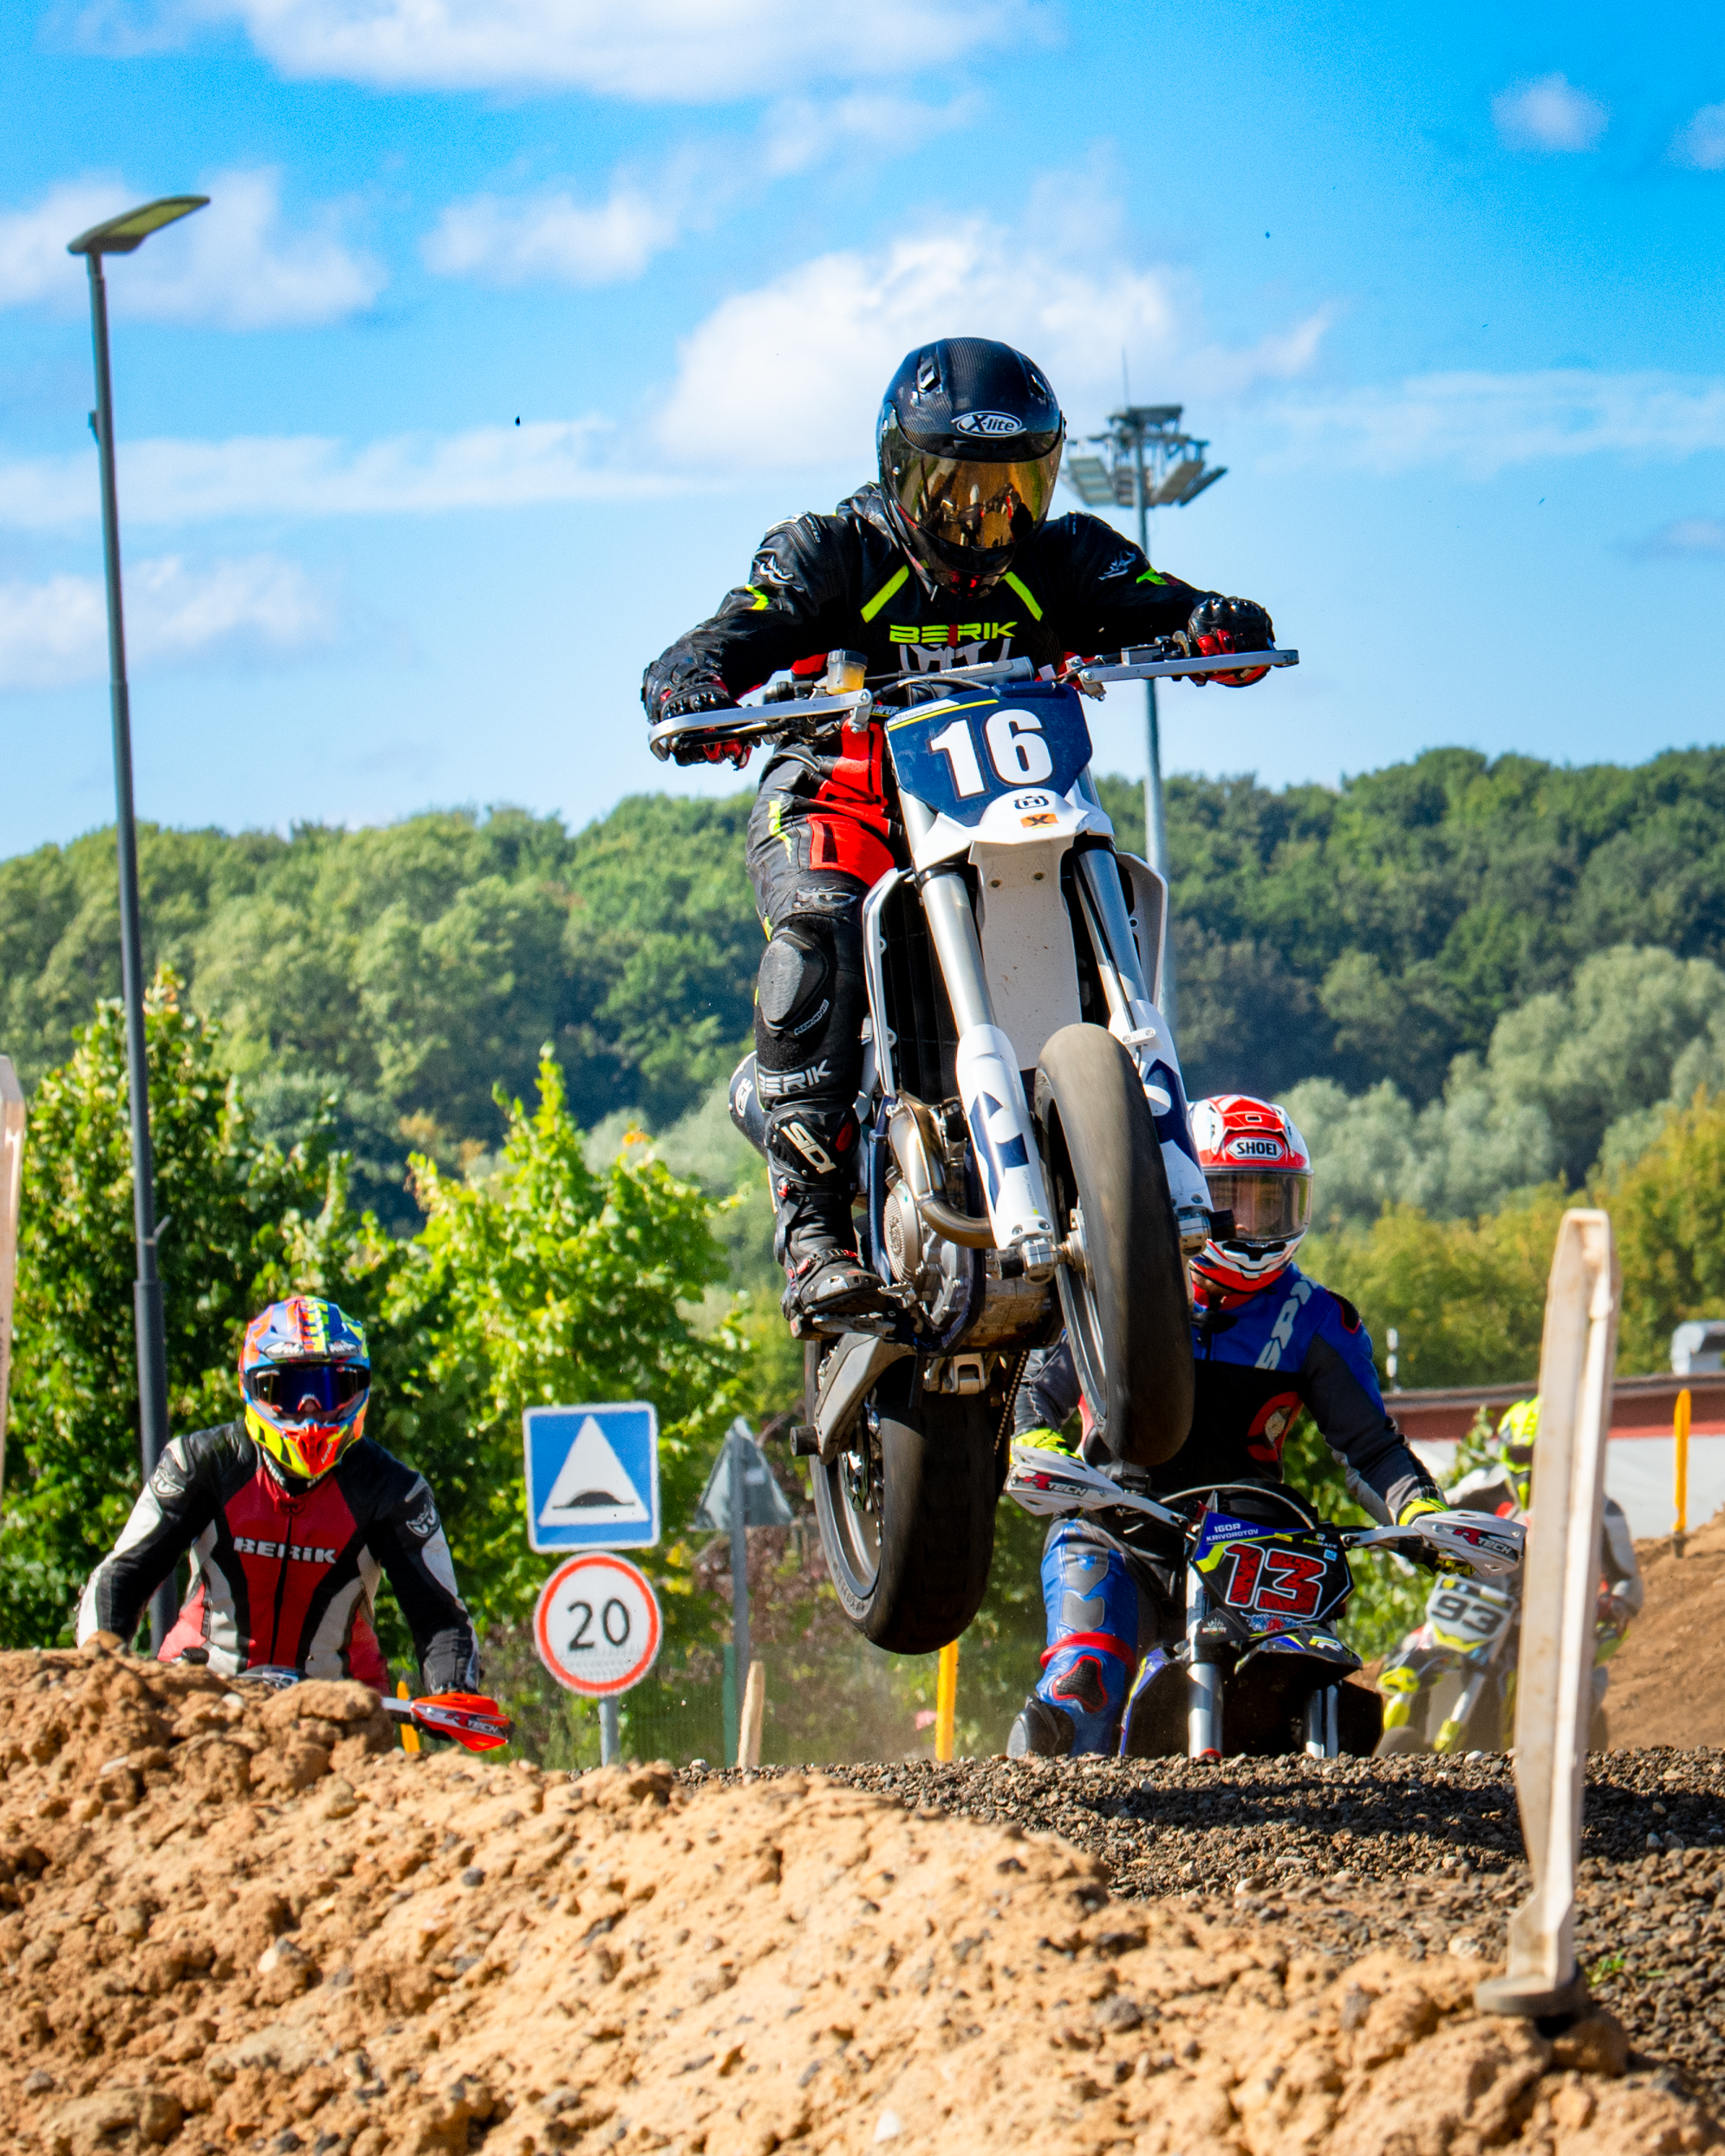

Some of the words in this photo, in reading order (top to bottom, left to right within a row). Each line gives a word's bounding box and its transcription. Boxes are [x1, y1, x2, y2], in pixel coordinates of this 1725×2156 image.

[966, 414, 1015, 433] X-lite
[889, 621, 1018, 644] BERIK
[929, 708, 1054, 798] 16
[1236, 1141, 1277, 1156] SHOEI
[1206, 1528, 1259, 1542] KRIVOROTOV
[1214, 1522, 1241, 1534] IGOR
[1223, 1541, 1327, 1619] 13
[567, 1598, 631, 1651] 20
[1431, 1594, 1504, 1636] 93
